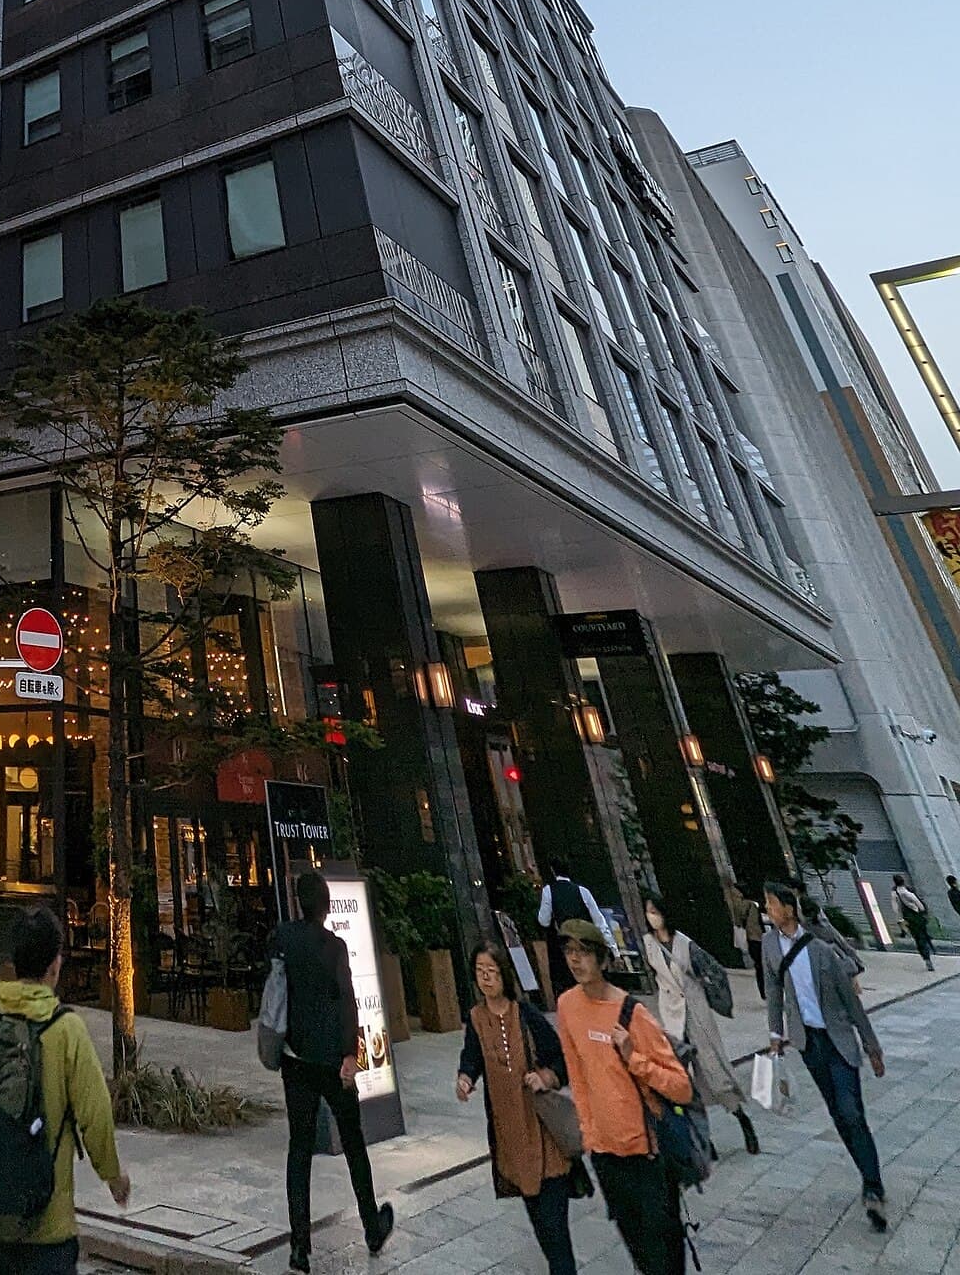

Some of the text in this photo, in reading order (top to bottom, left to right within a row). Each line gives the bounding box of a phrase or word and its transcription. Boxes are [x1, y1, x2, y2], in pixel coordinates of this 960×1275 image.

[20, 678, 59, 695] 自転車を除く
[274, 821, 329, 839] TRUST TOWER
[330, 899, 358, 913] RTYARD
